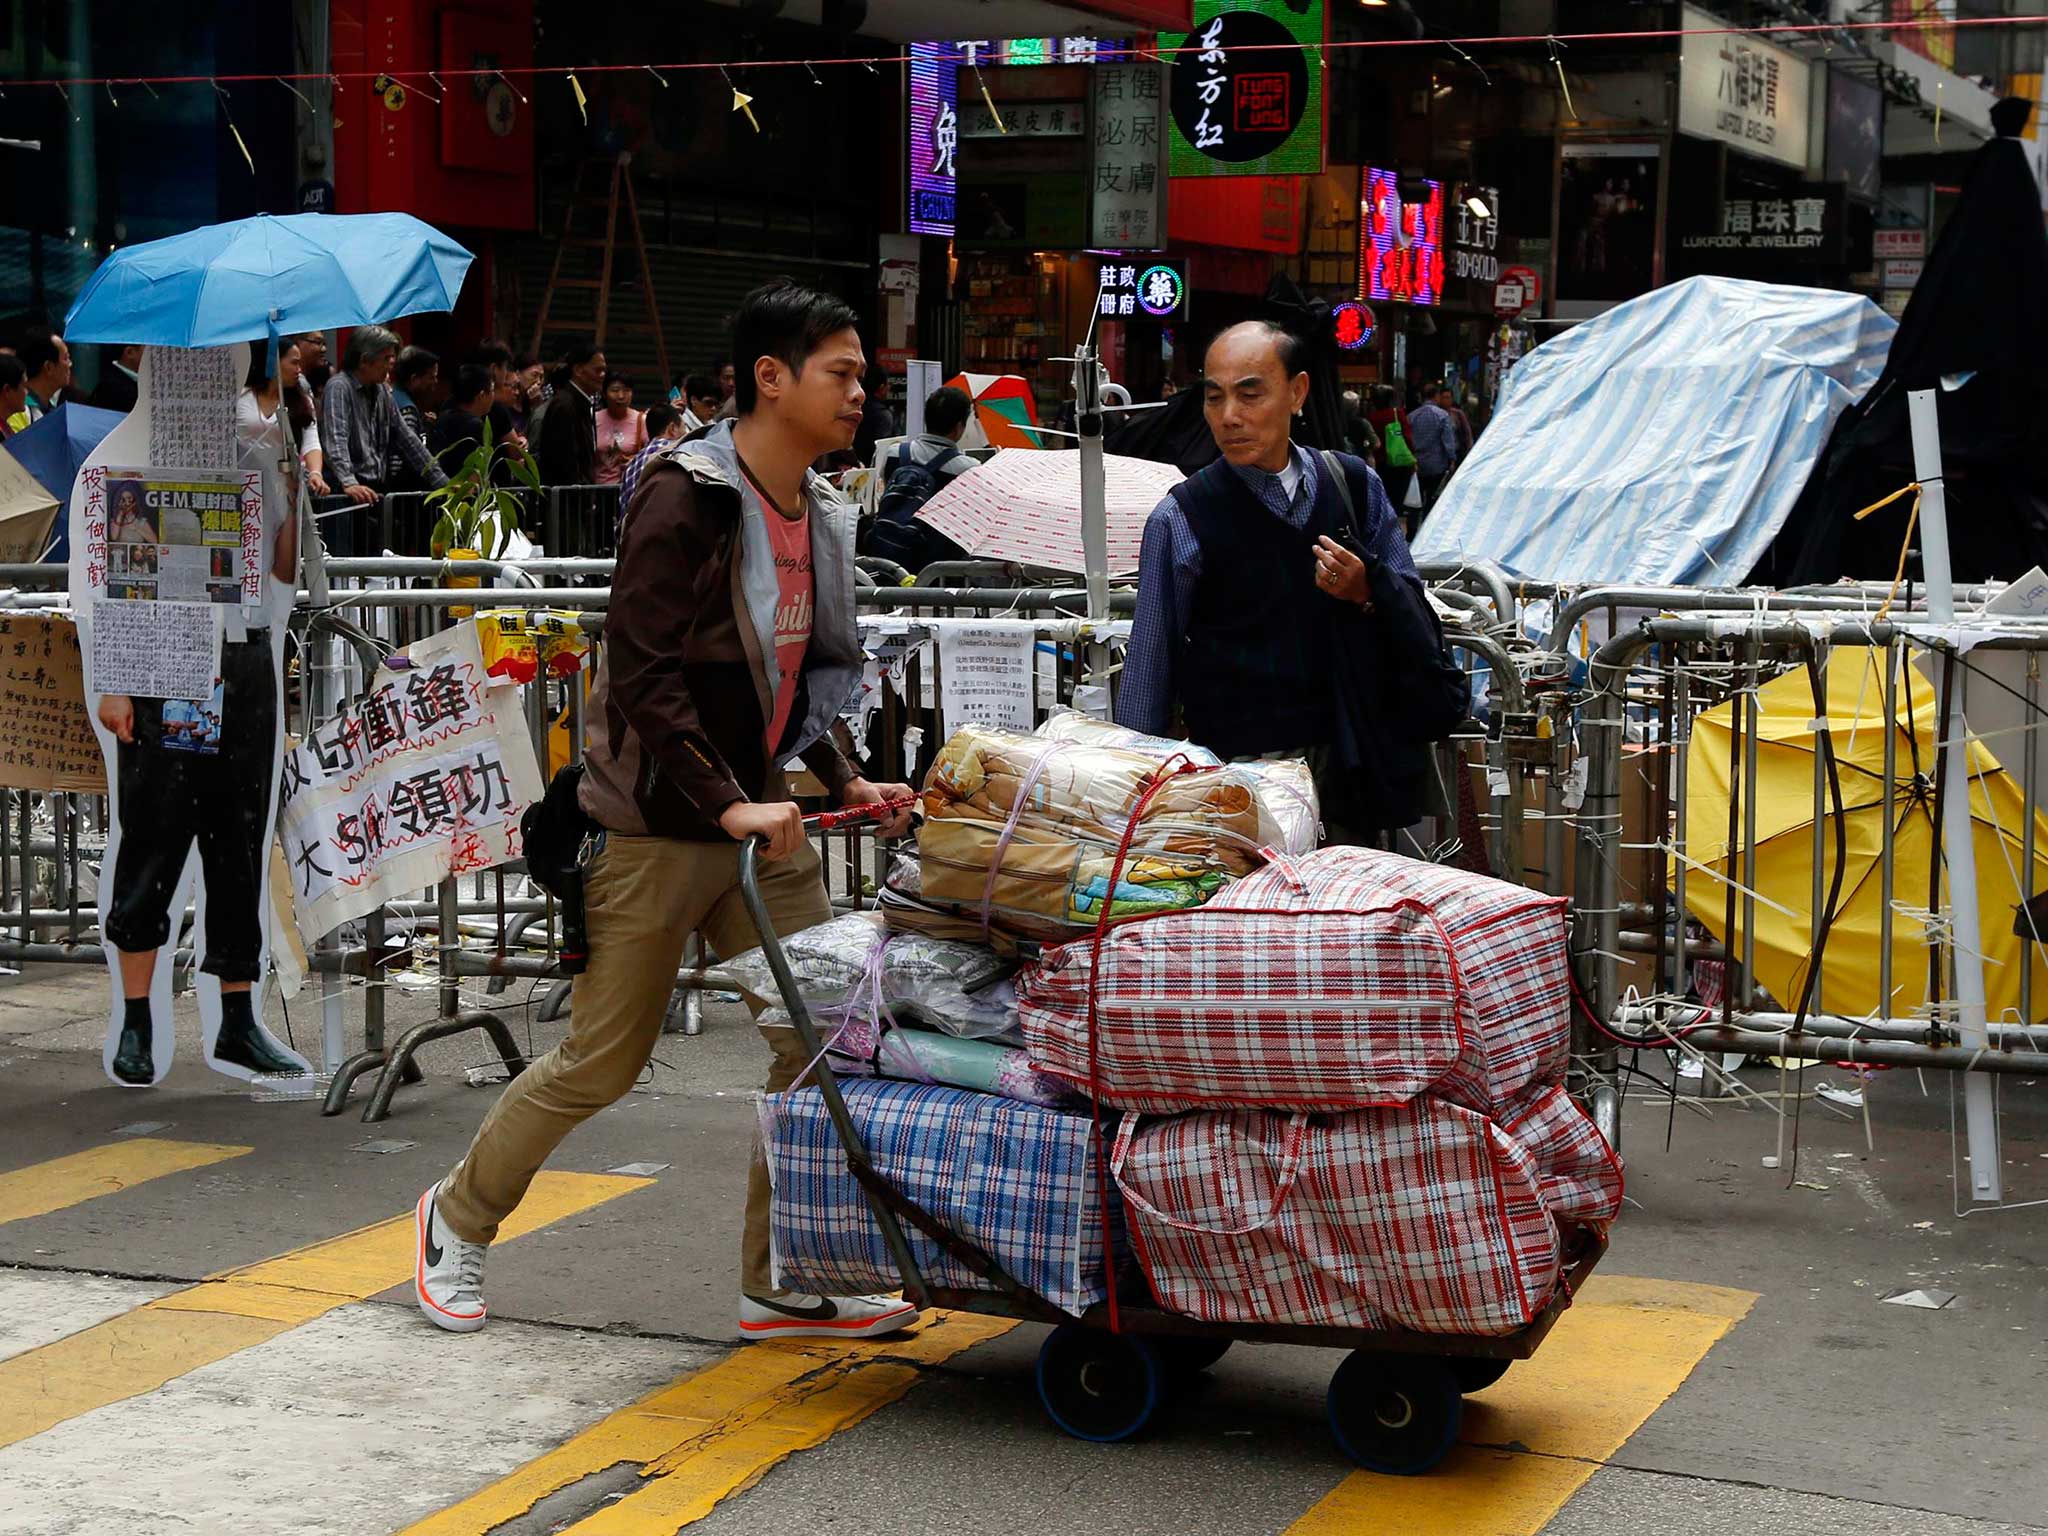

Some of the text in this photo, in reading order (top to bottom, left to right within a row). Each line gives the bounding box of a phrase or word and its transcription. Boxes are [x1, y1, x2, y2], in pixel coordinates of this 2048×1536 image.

[303, 188, 325, 206] ADT
[1682, 234, 1824, 249] LUKFOOK JEWELLERY
